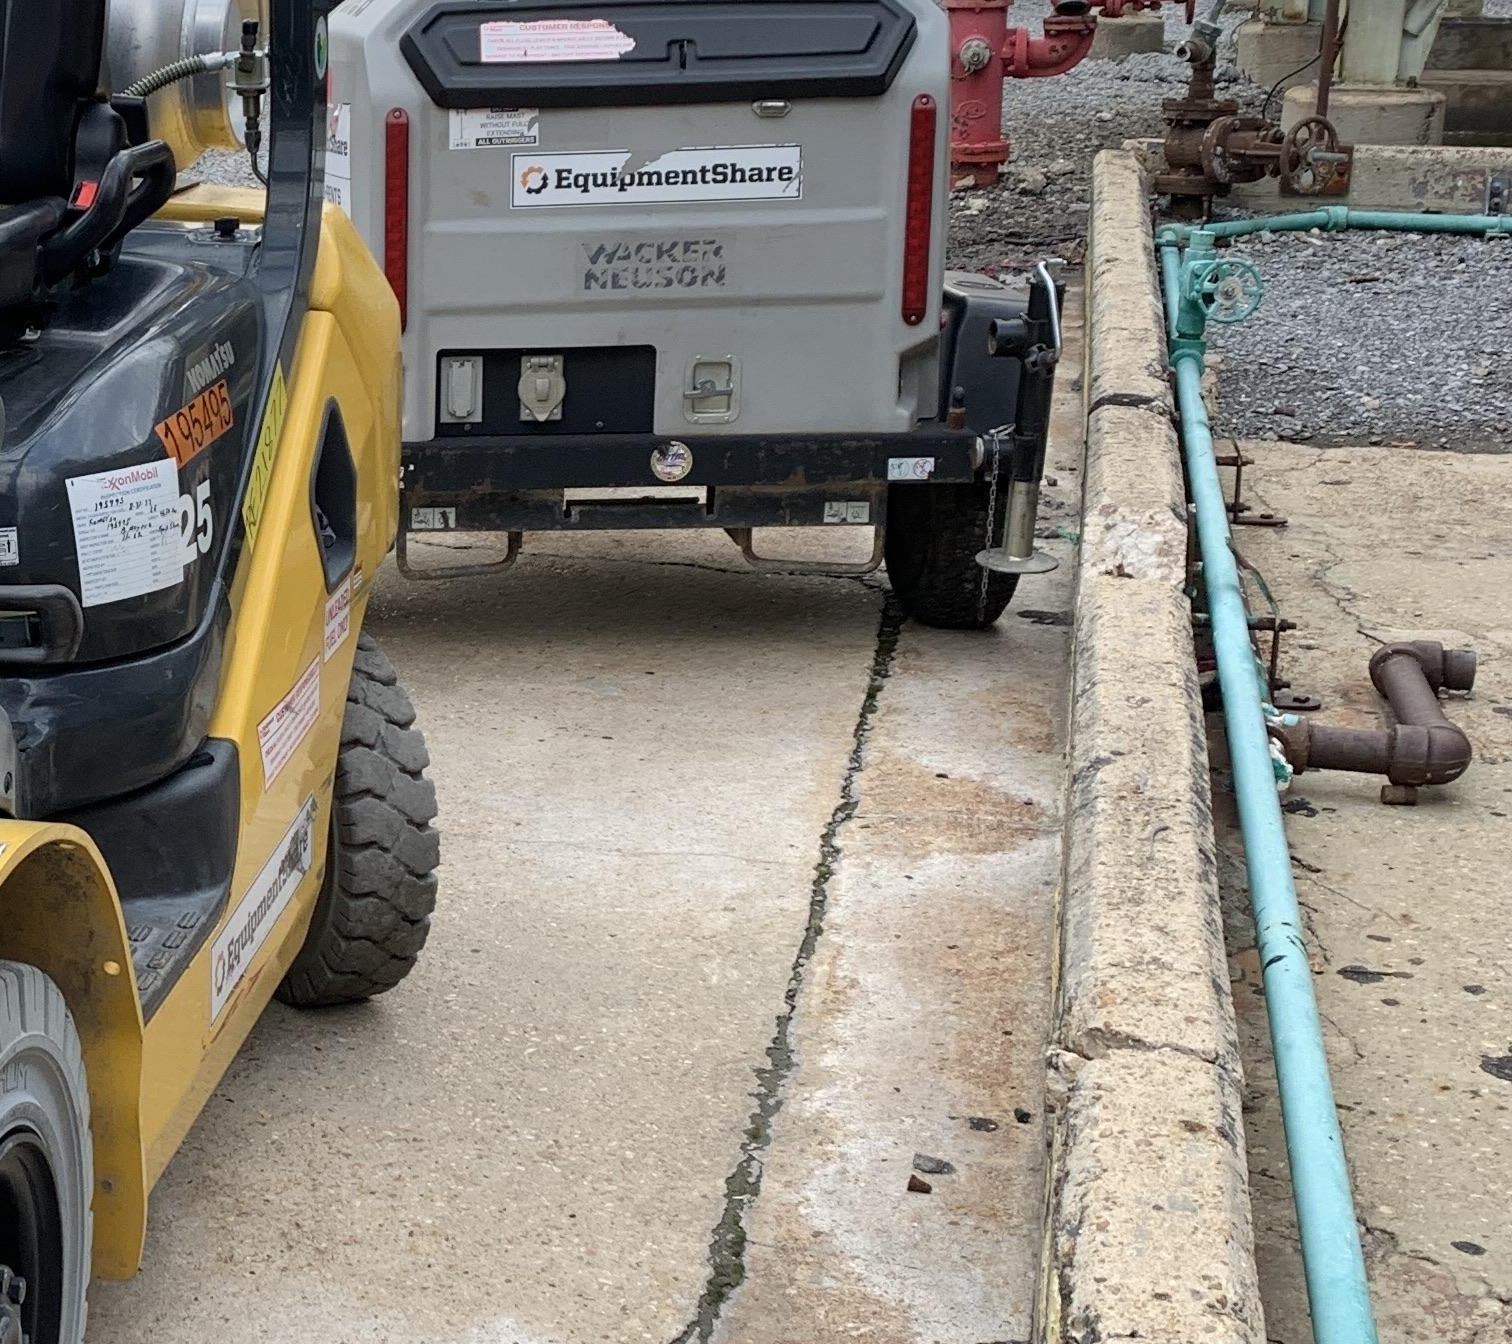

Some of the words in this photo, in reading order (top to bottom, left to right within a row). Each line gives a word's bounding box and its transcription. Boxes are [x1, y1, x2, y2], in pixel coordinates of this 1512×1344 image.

[519, 23, 568, 32] CUSTOMER
[553, 162, 793, 193] EquipmentShare
[583, 265, 726, 289] NEUSON
[187, 339, 236, 393] KOMATSU
[164, 382, 232, 463] 195495
[178, 479, 213, 566] 25
[226, 824, 311, 973] EquipmentSre
